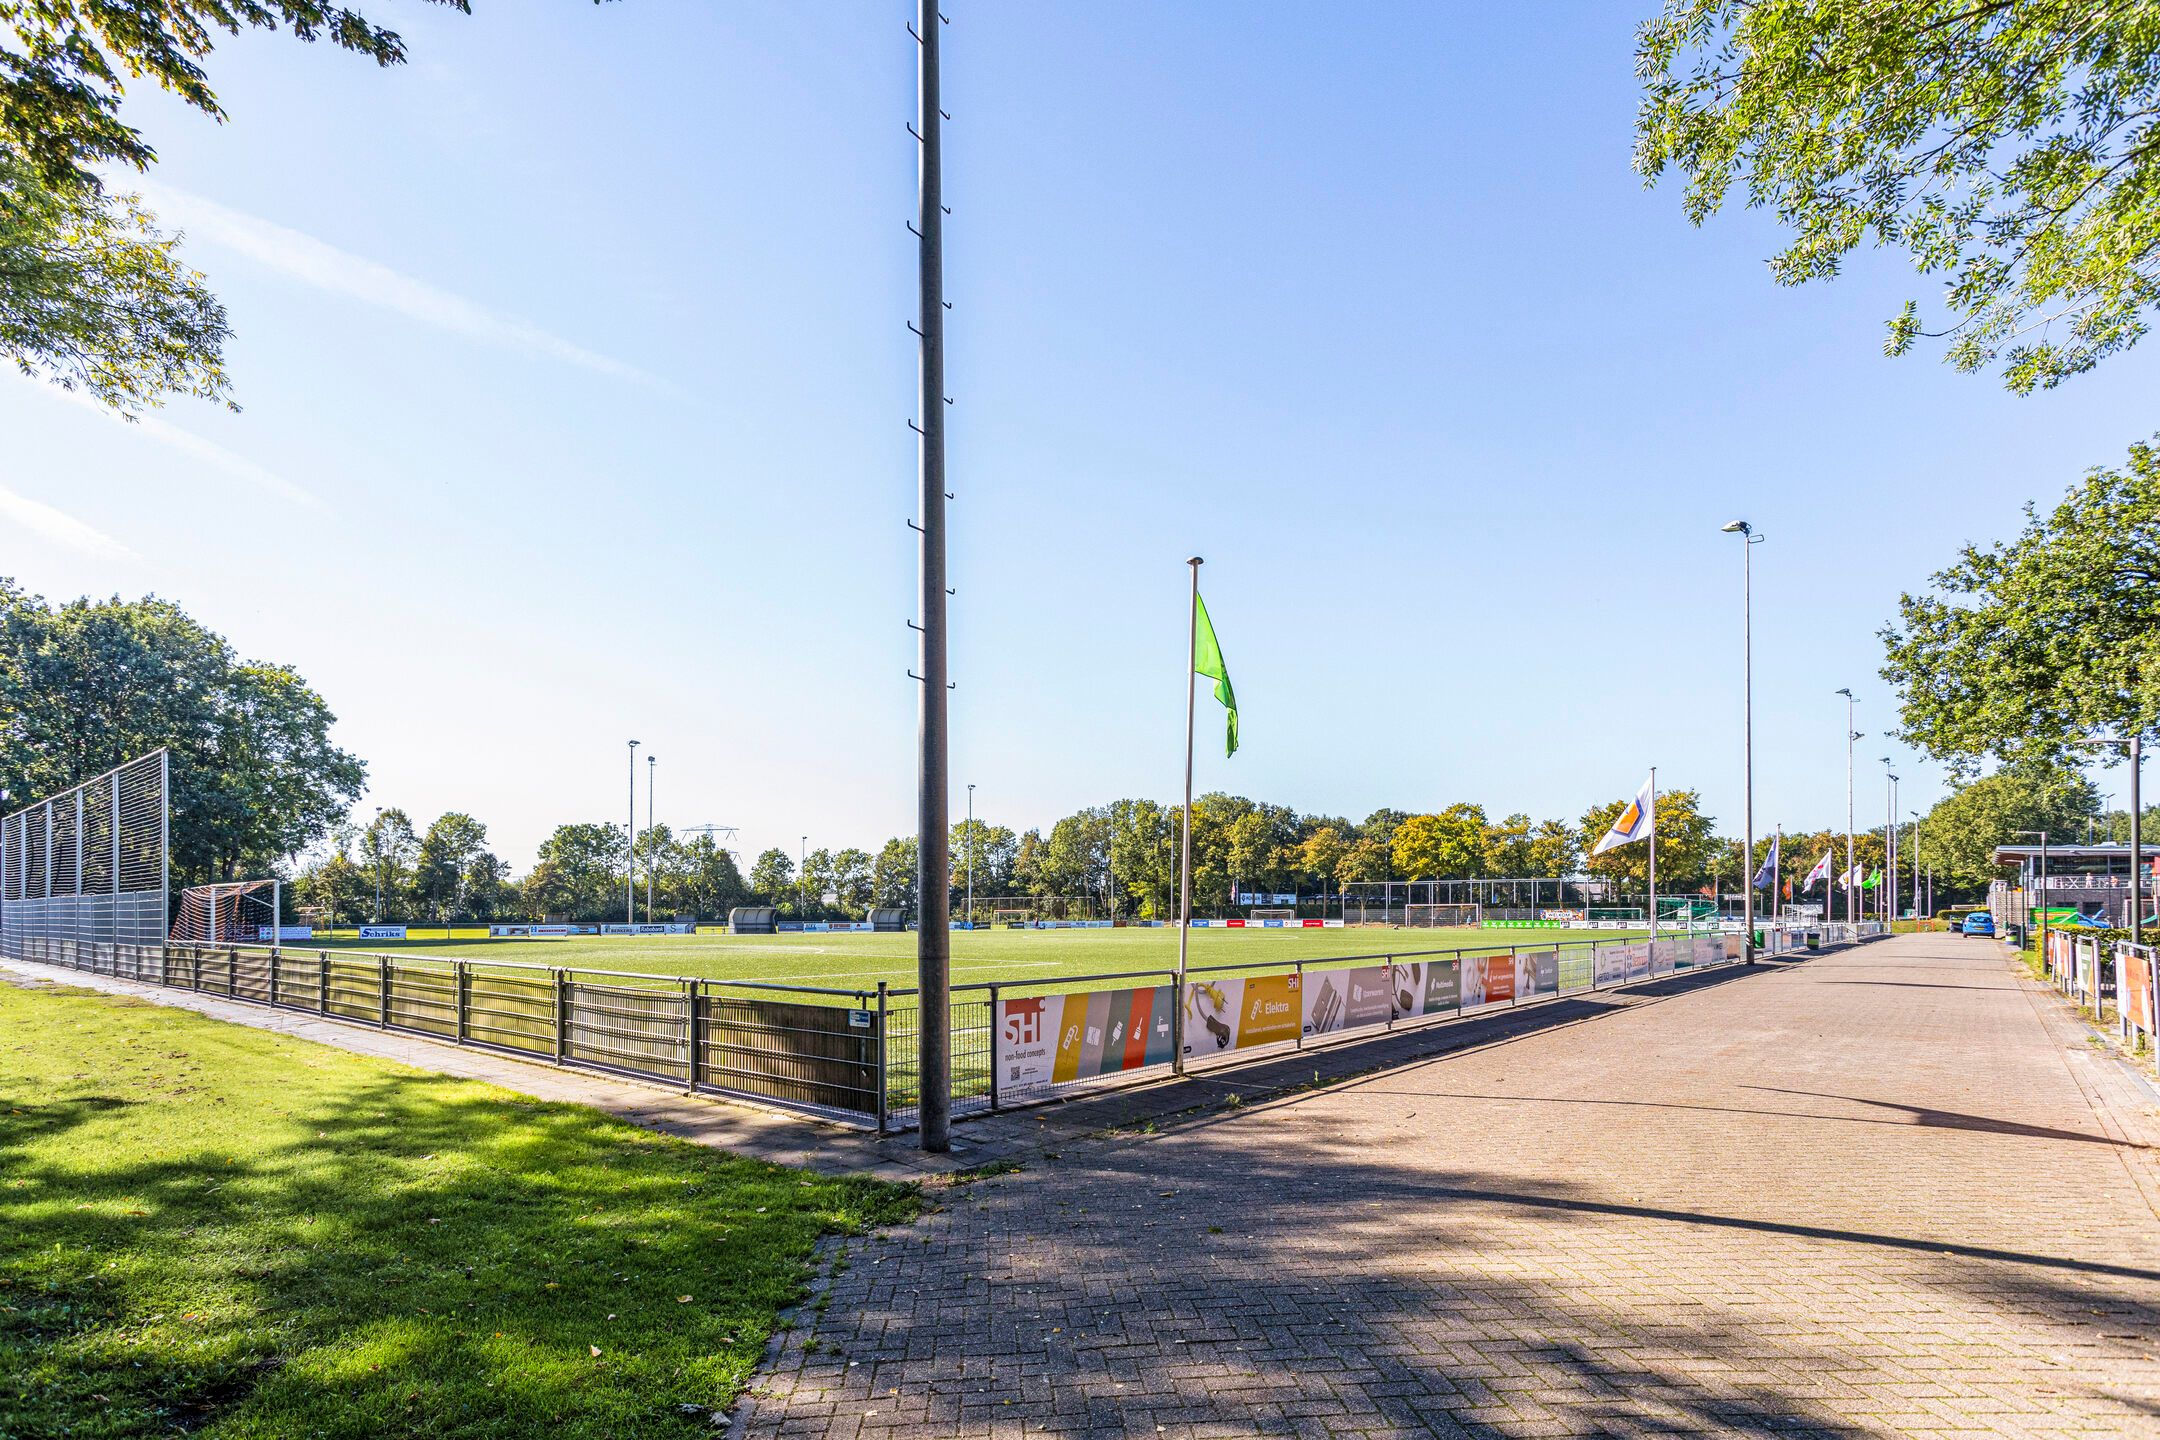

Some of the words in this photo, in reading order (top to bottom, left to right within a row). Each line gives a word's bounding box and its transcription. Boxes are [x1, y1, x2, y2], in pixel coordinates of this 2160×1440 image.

[361, 928, 401, 938] Schriks
[1265, 1001, 1289, 1015] Elektra
[1005, 1050, 1027, 1062] non-food
[1027, 1048, 1046, 1060] concepts
